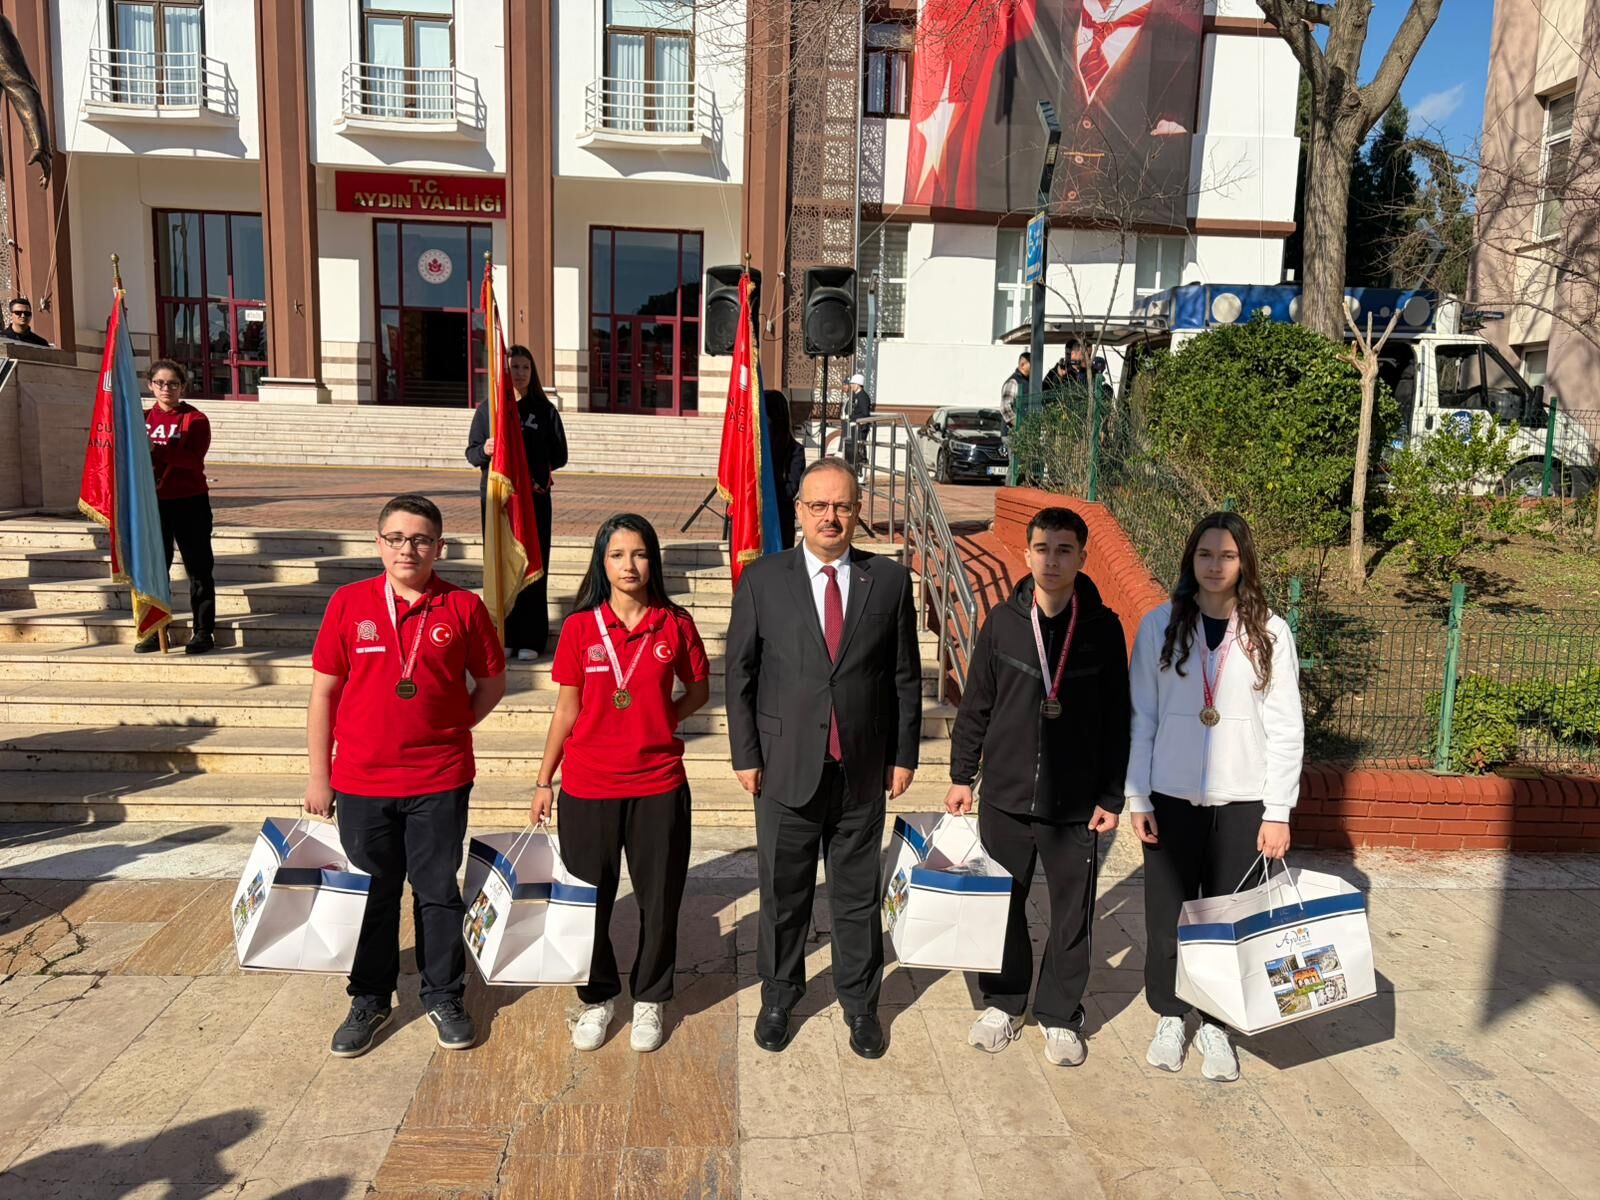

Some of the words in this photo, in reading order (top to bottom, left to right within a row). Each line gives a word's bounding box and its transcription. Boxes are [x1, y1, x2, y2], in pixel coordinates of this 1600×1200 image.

[408, 179, 444, 194] T.C.
[353, 192, 412, 209] AYDIN
[416, 194, 502, 213] VALİLİĞİ
